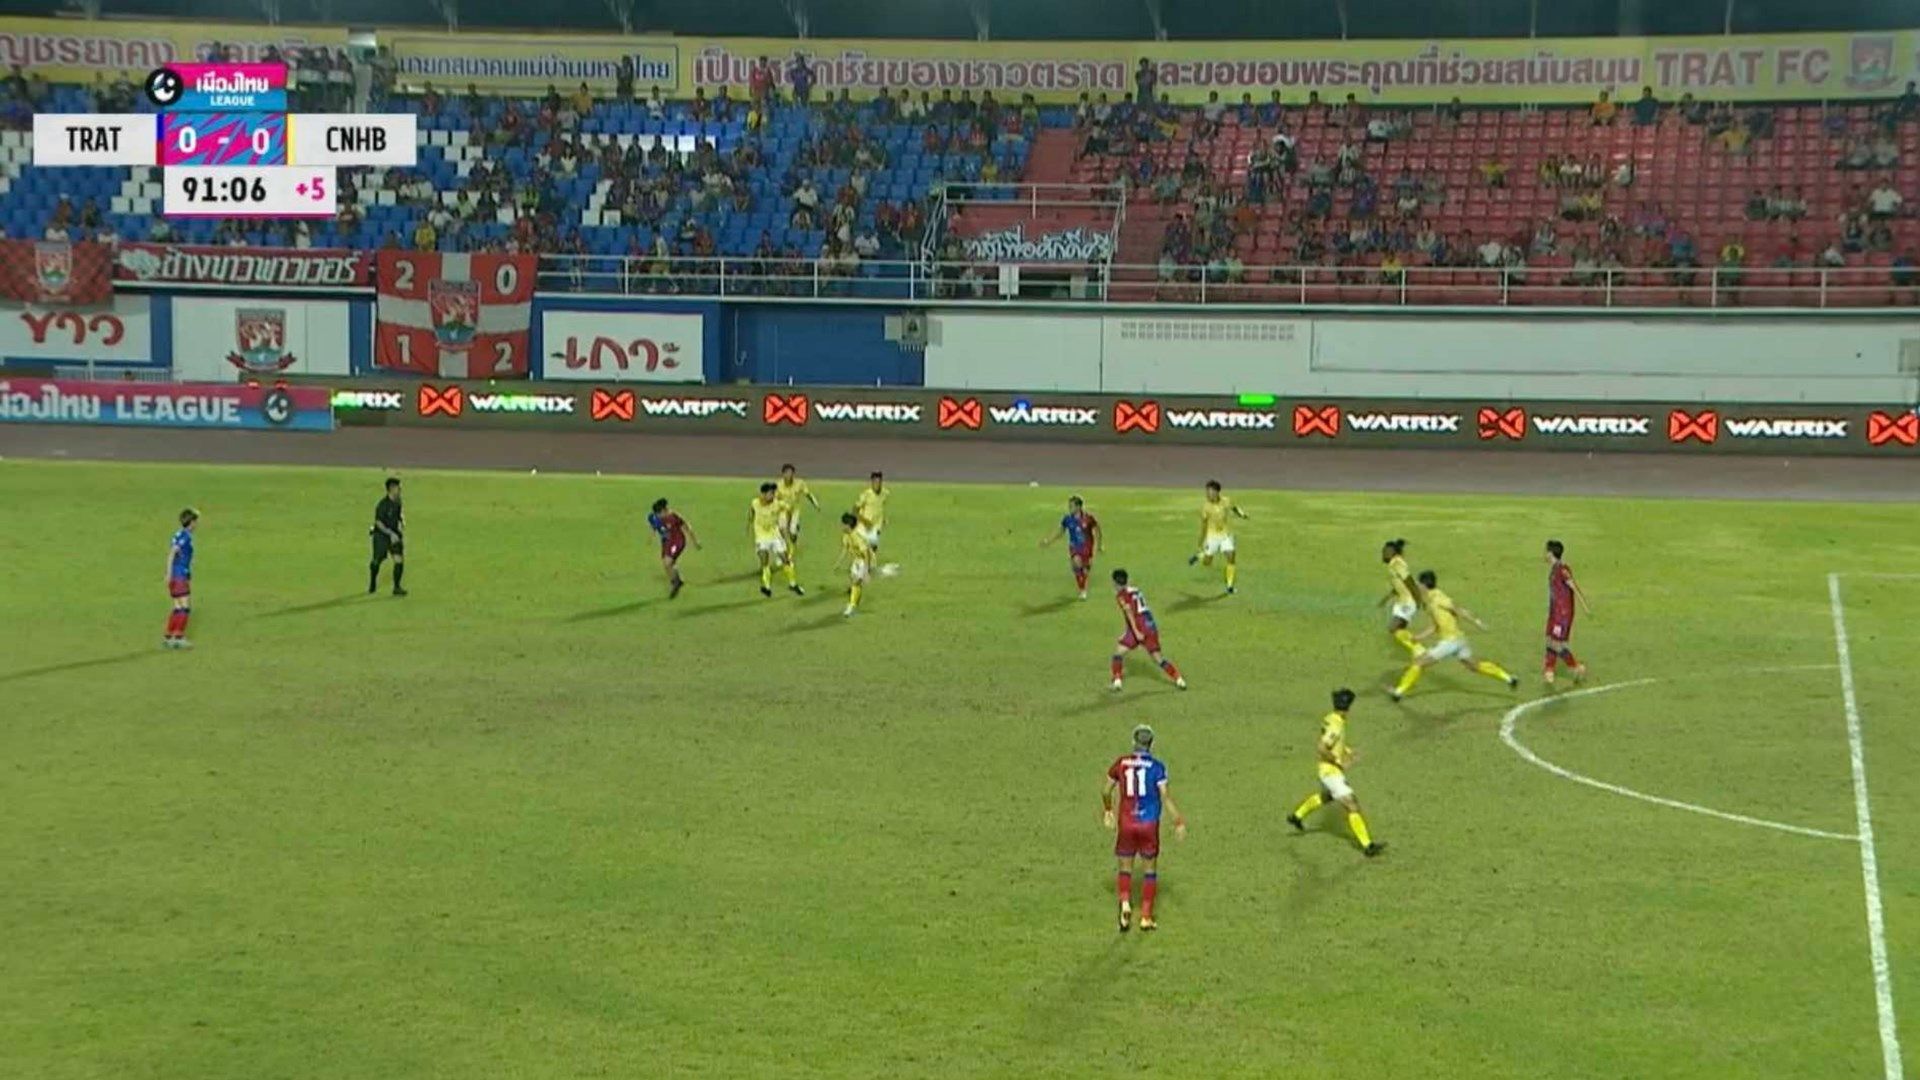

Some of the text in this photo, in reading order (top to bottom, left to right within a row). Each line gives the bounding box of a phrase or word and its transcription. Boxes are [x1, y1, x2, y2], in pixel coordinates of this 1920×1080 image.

[398, 54, 670, 80] นายกสมาคมแม่บ้านมหาไทย
[1655, 50, 1763, 86] TRAT
[1778, 48, 1831, 84] FC
[394, 260, 517, 295] 2 0
[20, 310, 125, 346] ขาว
[396, 334, 513, 372] 1 2
[116, 394, 240, 422] LEAGUE
[470, 394, 575, 412] WARRIX
[815, 402, 921, 421] WARRIX
[989, 407, 1097, 424] WARRIX
[1167, 410, 1277, 428] WARRIX
[1347, 414, 1460, 431] WARRIX
[1534, 416, 1649, 434] WARRIX
[1725, 419, 1847, 436] WARRIX
[1124, 768, 1147, 797] 11
